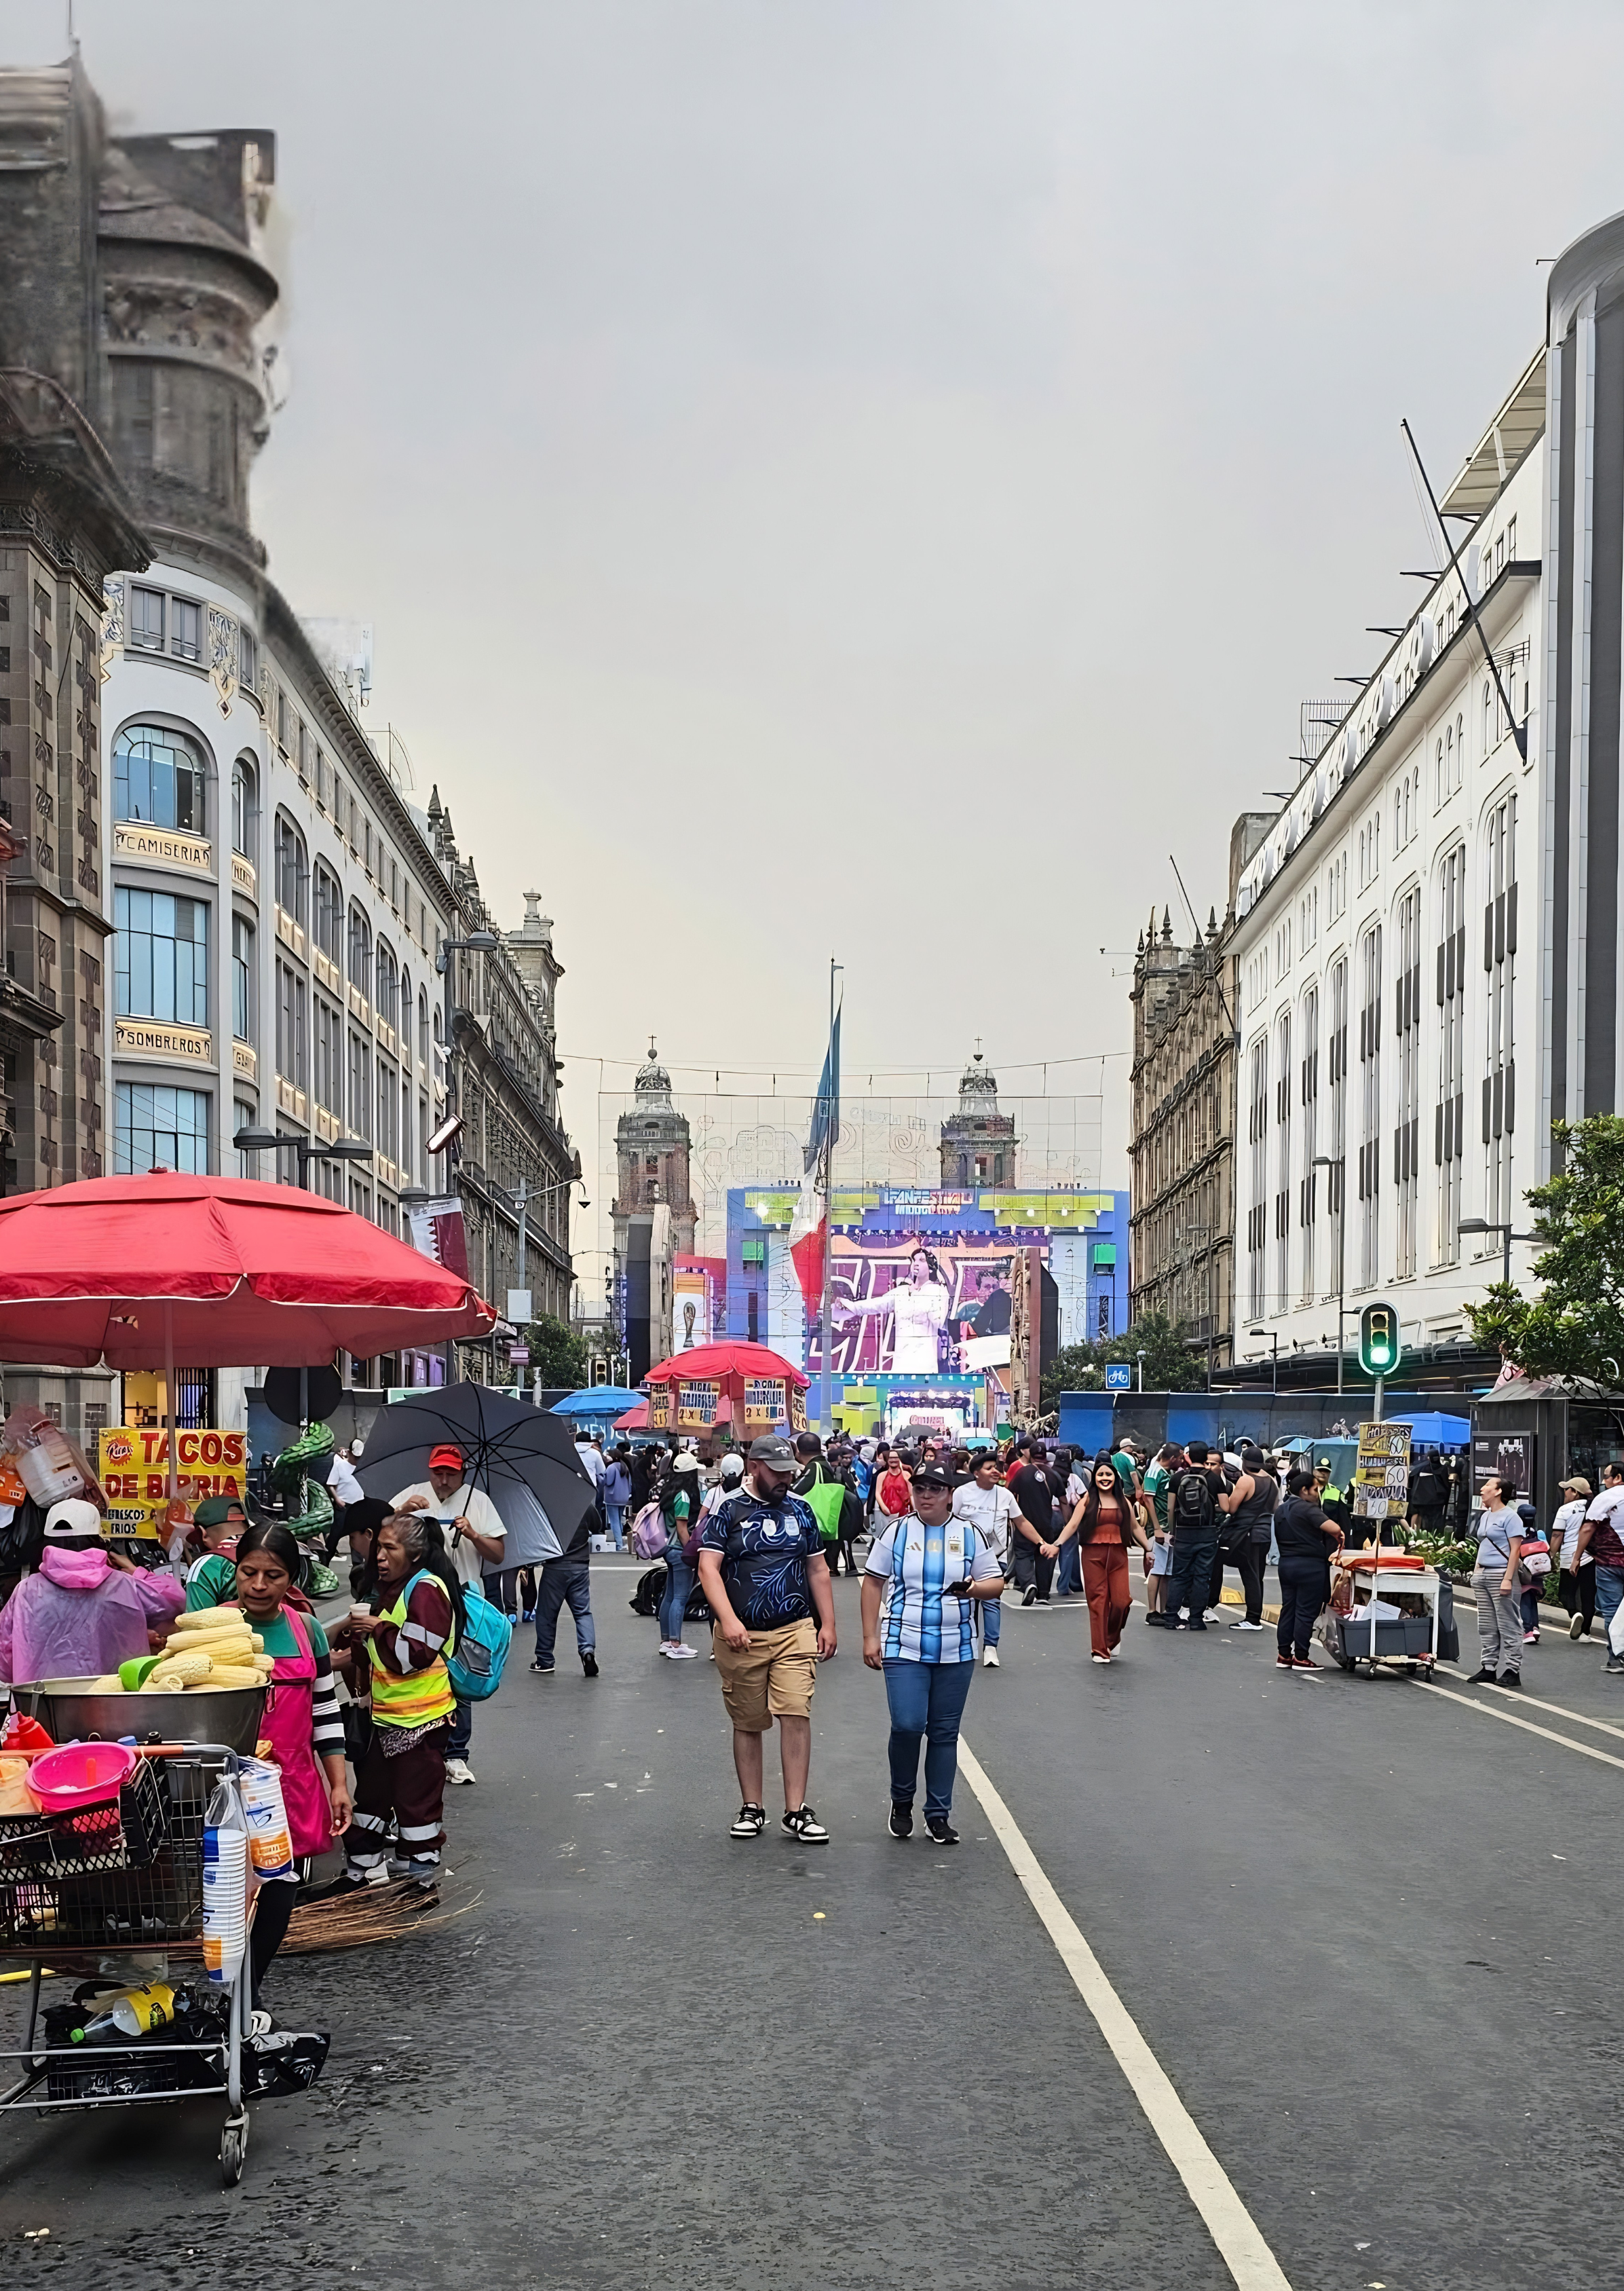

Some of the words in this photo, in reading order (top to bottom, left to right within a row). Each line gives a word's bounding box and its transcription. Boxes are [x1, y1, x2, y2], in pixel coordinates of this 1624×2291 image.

[127, 836, 201, 863] CAMISERIA
[127, 1032, 201, 1054] SOMBREROS
[140, 1433, 246, 1466] TACOS
[105, 1474, 138, 1499] DE
[111, 1523, 136, 1534] FRIOS
